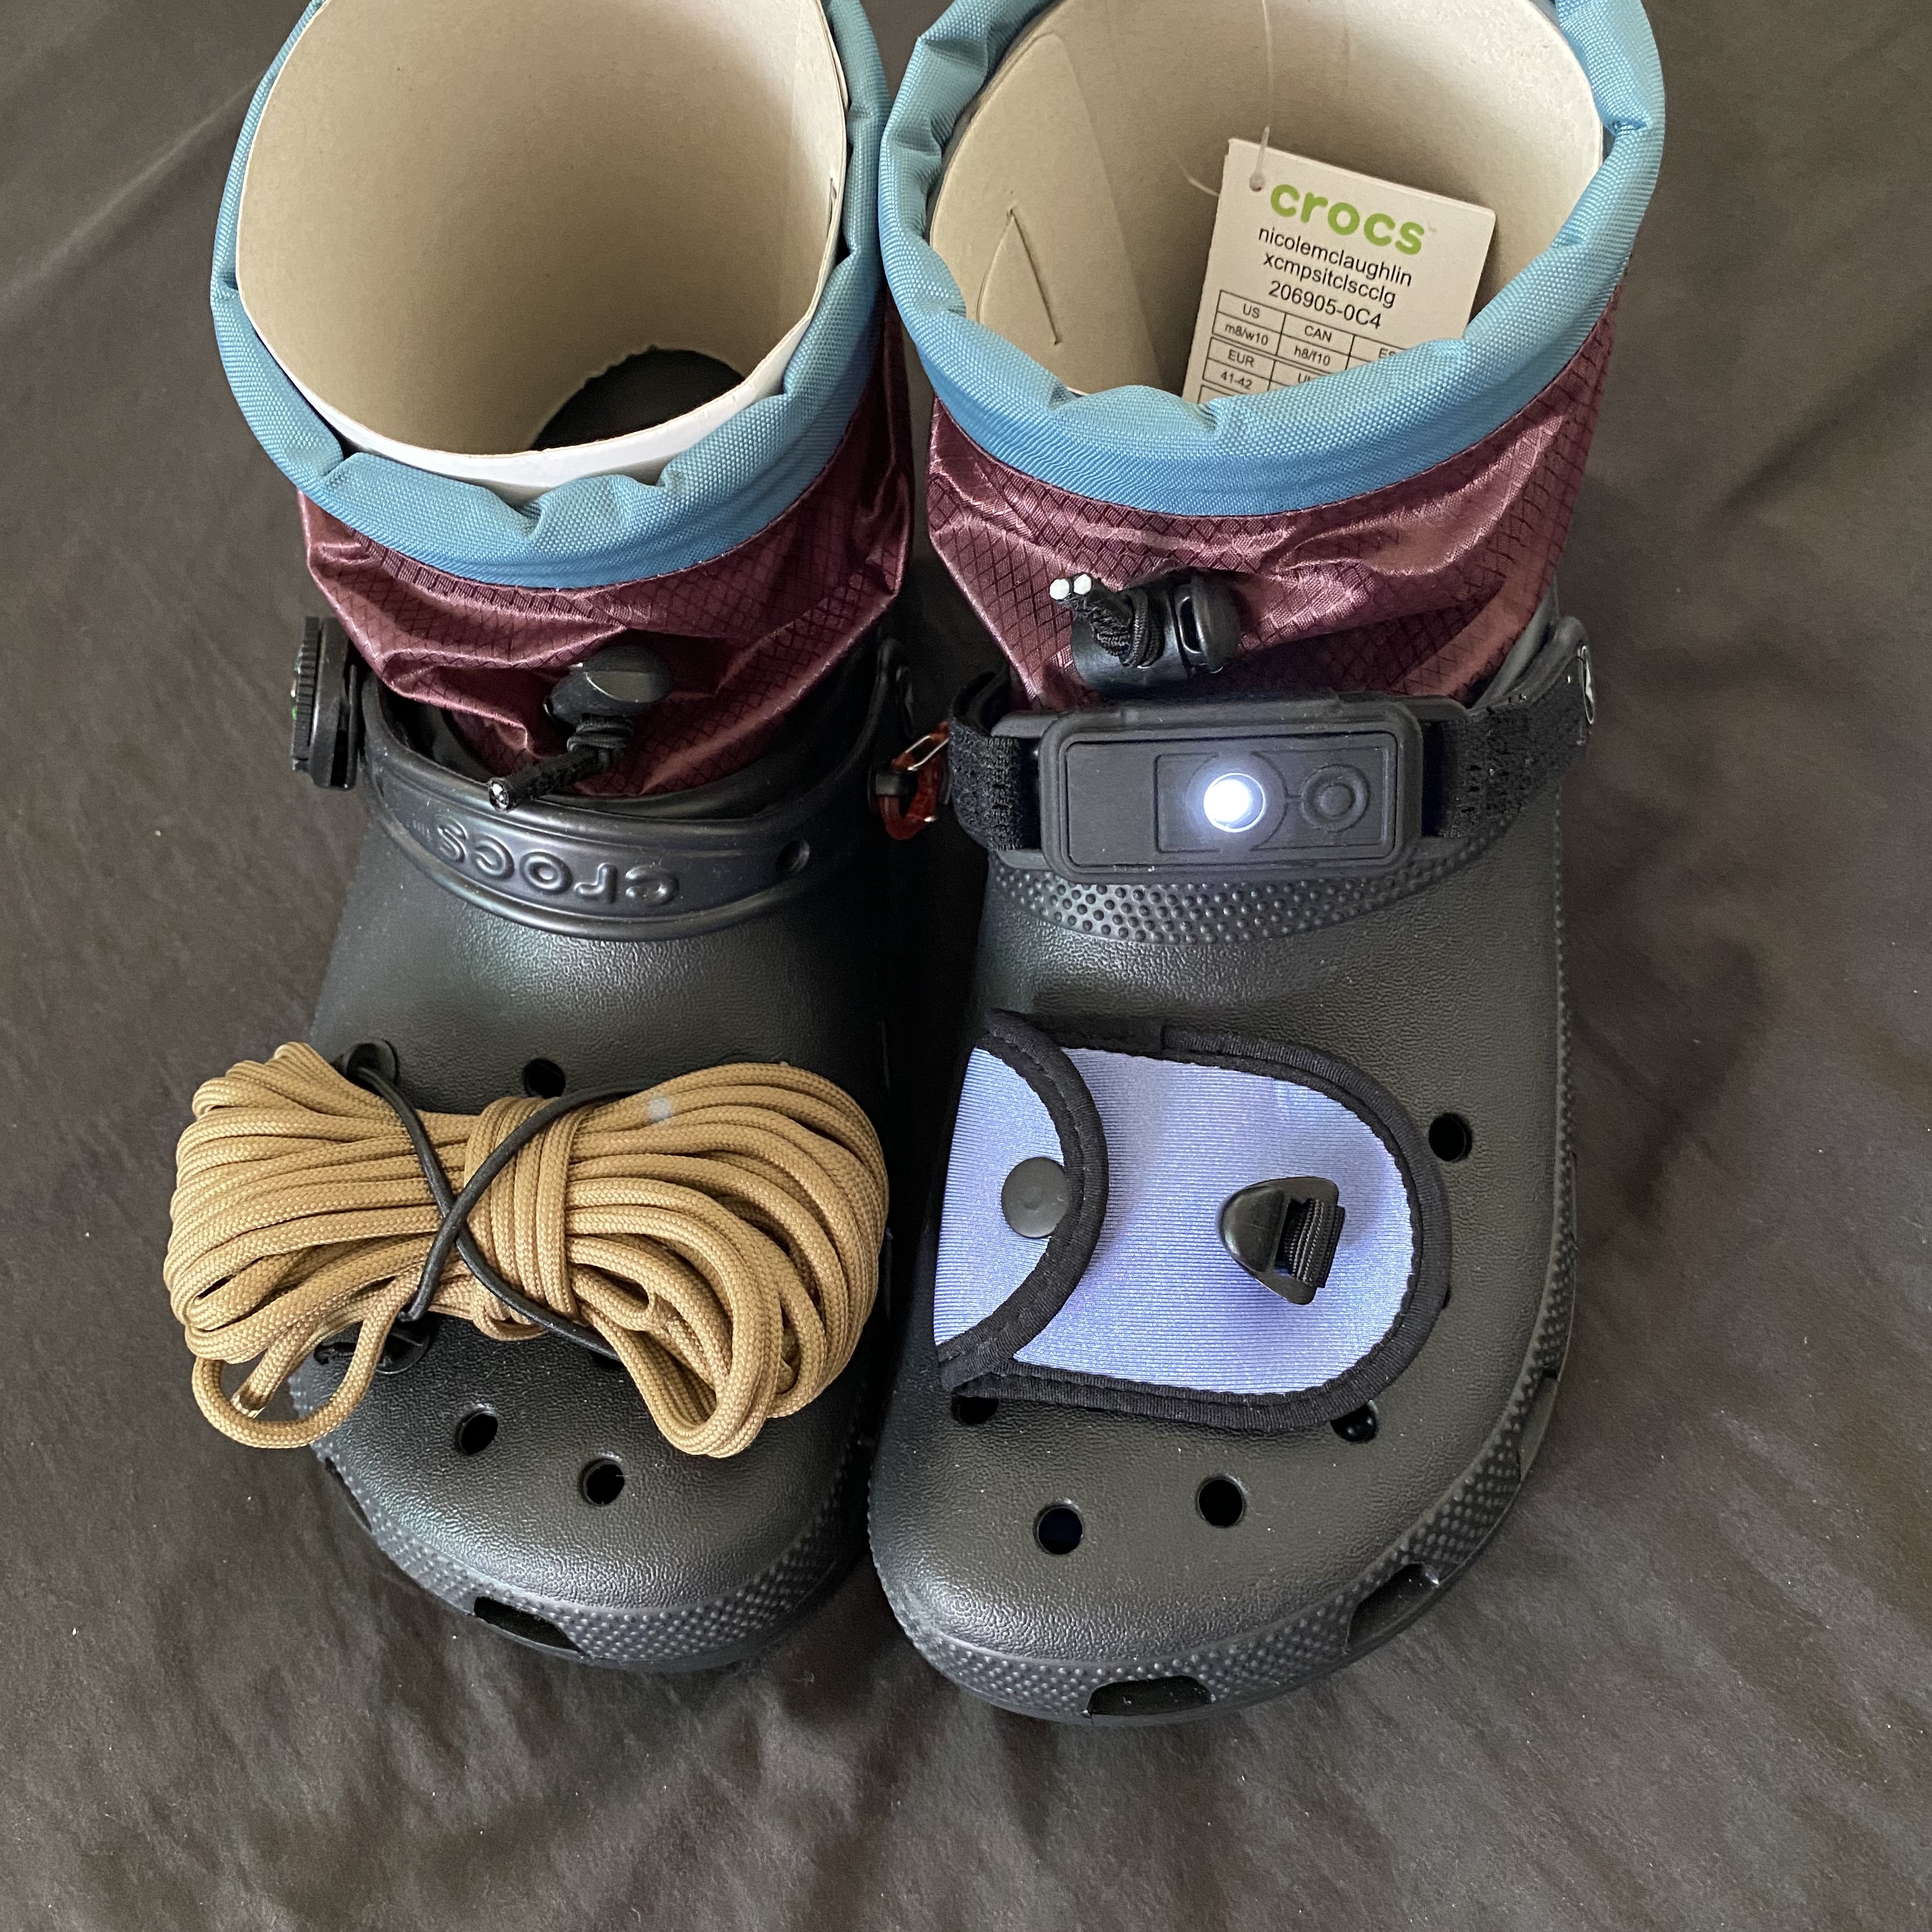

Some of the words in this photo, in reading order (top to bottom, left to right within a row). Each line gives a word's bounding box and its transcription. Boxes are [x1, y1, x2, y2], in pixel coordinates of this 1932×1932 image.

[1270, 184, 1425, 255] crocs
[1259, 227, 1412, 286] nicolemclaughlin
[1243, 303, 1260, 319] US
[1268, 280, 1382, 330] 206905-0C4
[1225, 324, 1269, 346] m8/w10
[1304, 325, 1332, 342] CAN
[1228, 349, 1254, 367] EUR
[1294, 345, 1331, 366] h8/f10
[1221, 371, 1252, 390] 41-42
[436, 816, 679, 906] crocs
